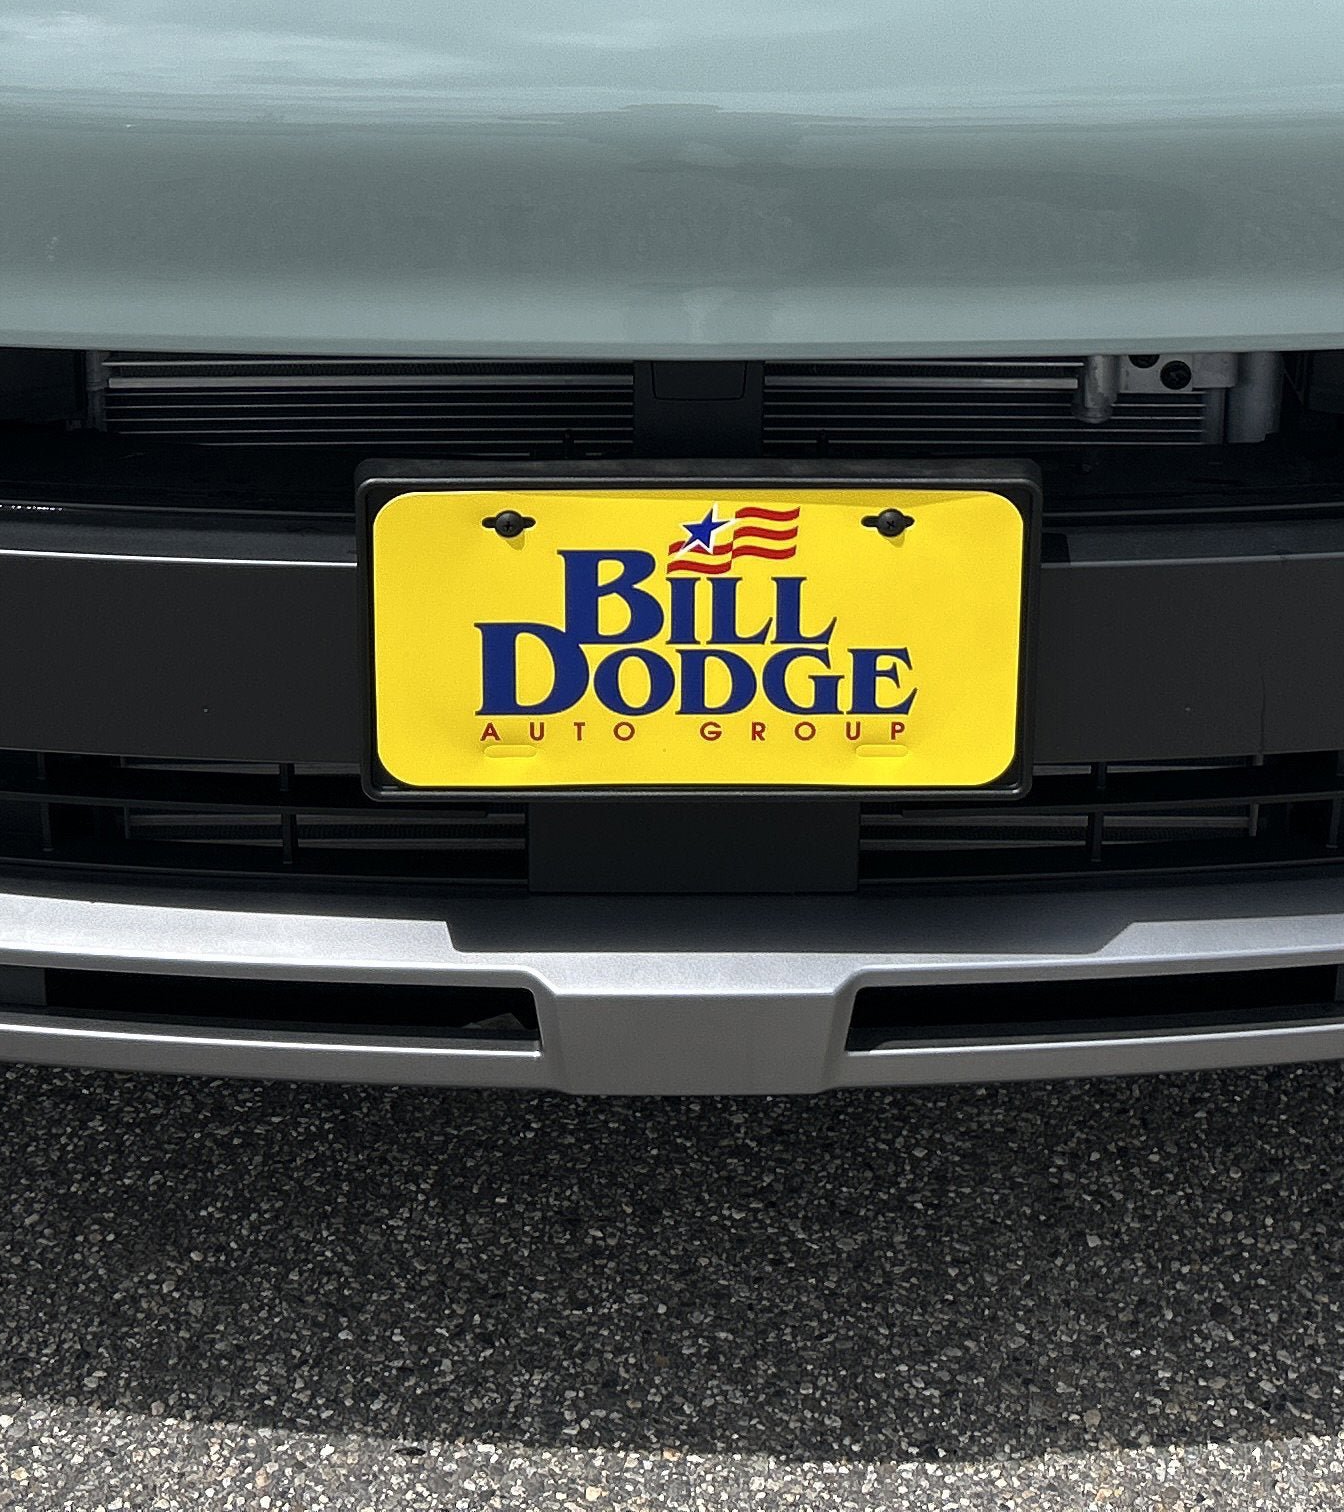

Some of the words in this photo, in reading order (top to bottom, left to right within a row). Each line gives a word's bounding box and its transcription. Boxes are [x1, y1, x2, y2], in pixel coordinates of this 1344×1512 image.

[556, 549, 838, 646] BILL
[473, 621, 919, 717] DODGE
[479, 721, 637, 743] AUTO
[699, 721, 907, 743] GROUP
